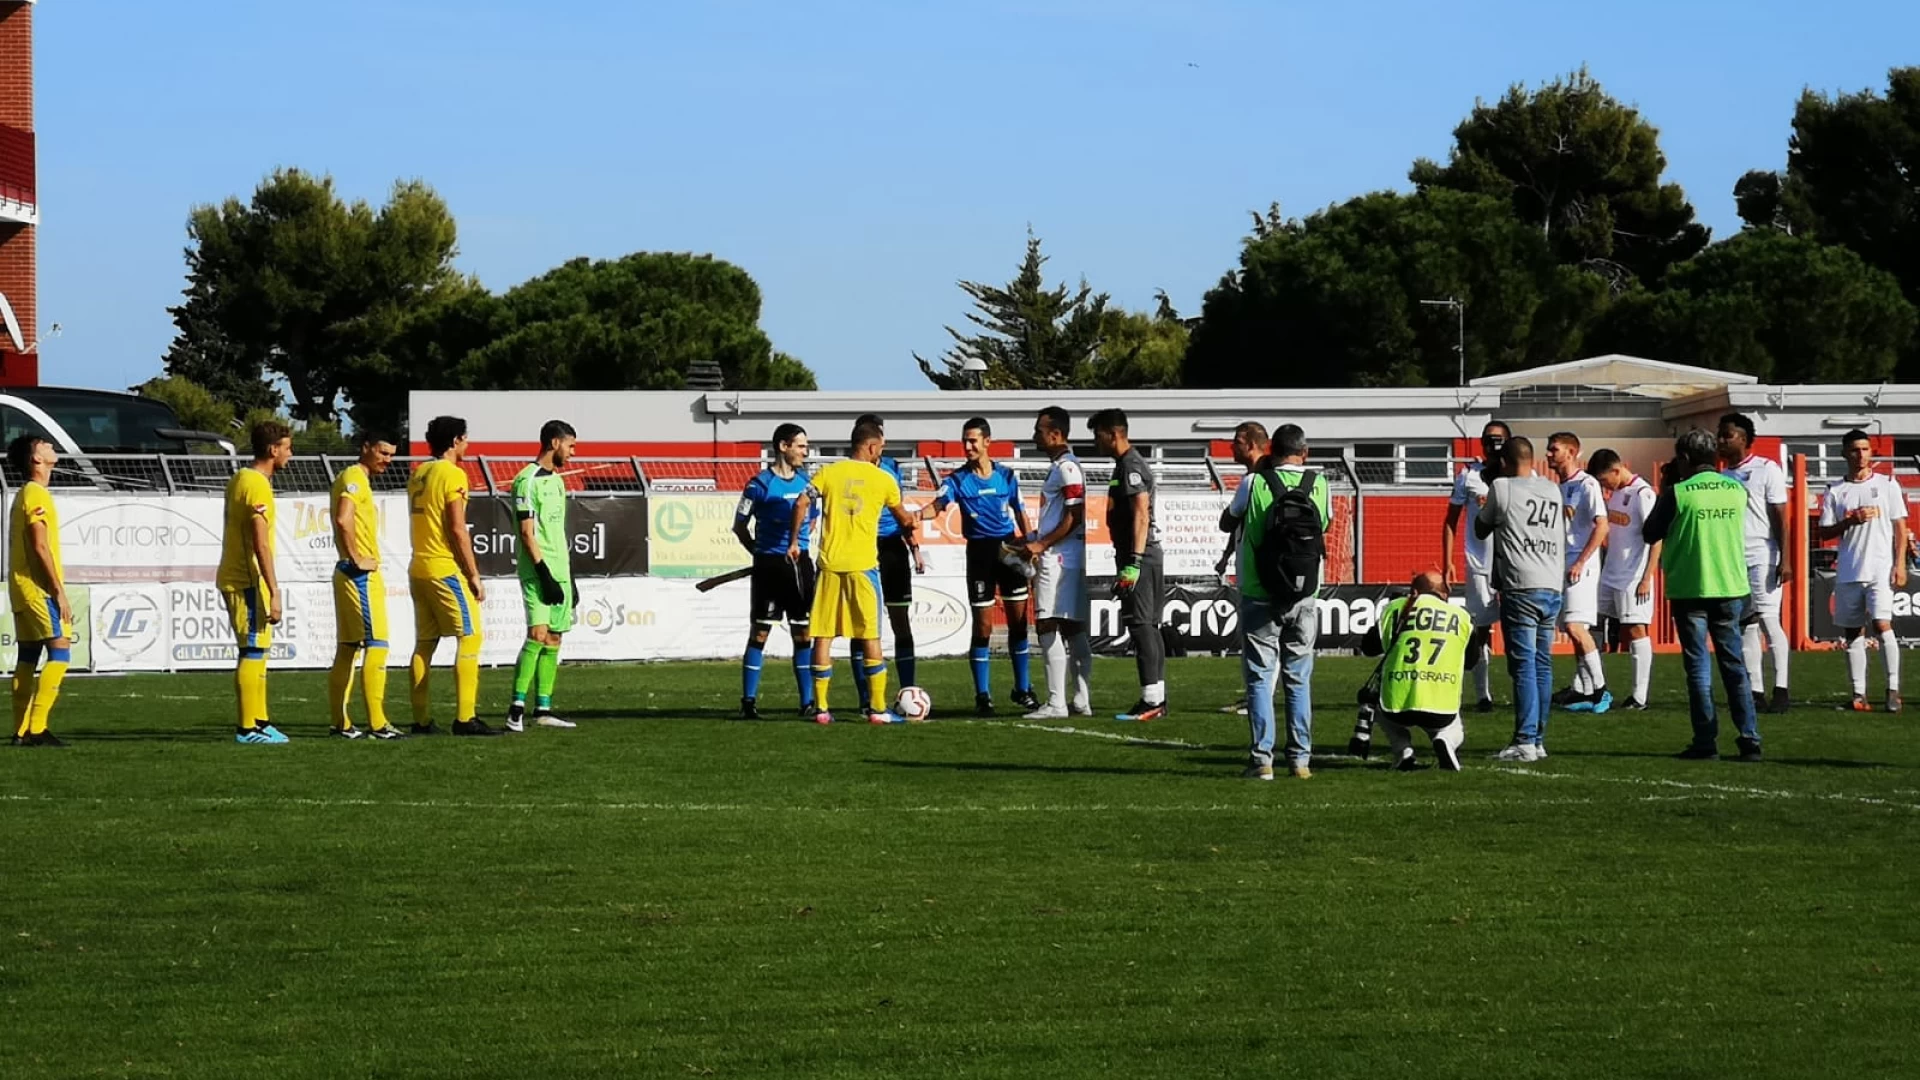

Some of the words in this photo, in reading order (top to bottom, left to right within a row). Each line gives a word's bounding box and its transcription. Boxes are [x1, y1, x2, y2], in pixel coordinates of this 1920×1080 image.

[1685, 480, 1739, 492] macron
[841, 477, 864, 515] 5
[1526, 499, 1558, 529] 247
[1697, 507, 1736, 520] STAFF
[1166, 524, 1209, 533] POMPE
[1166, 536, 1216, 544] SOLARE
[1524, 538, 1557, 556] PHOTO
[270, 646, 289, 658] Srl
[1403, 637, 1446, 666] 37
[1388, 670, 1457, 684] FOTOGRAFO
